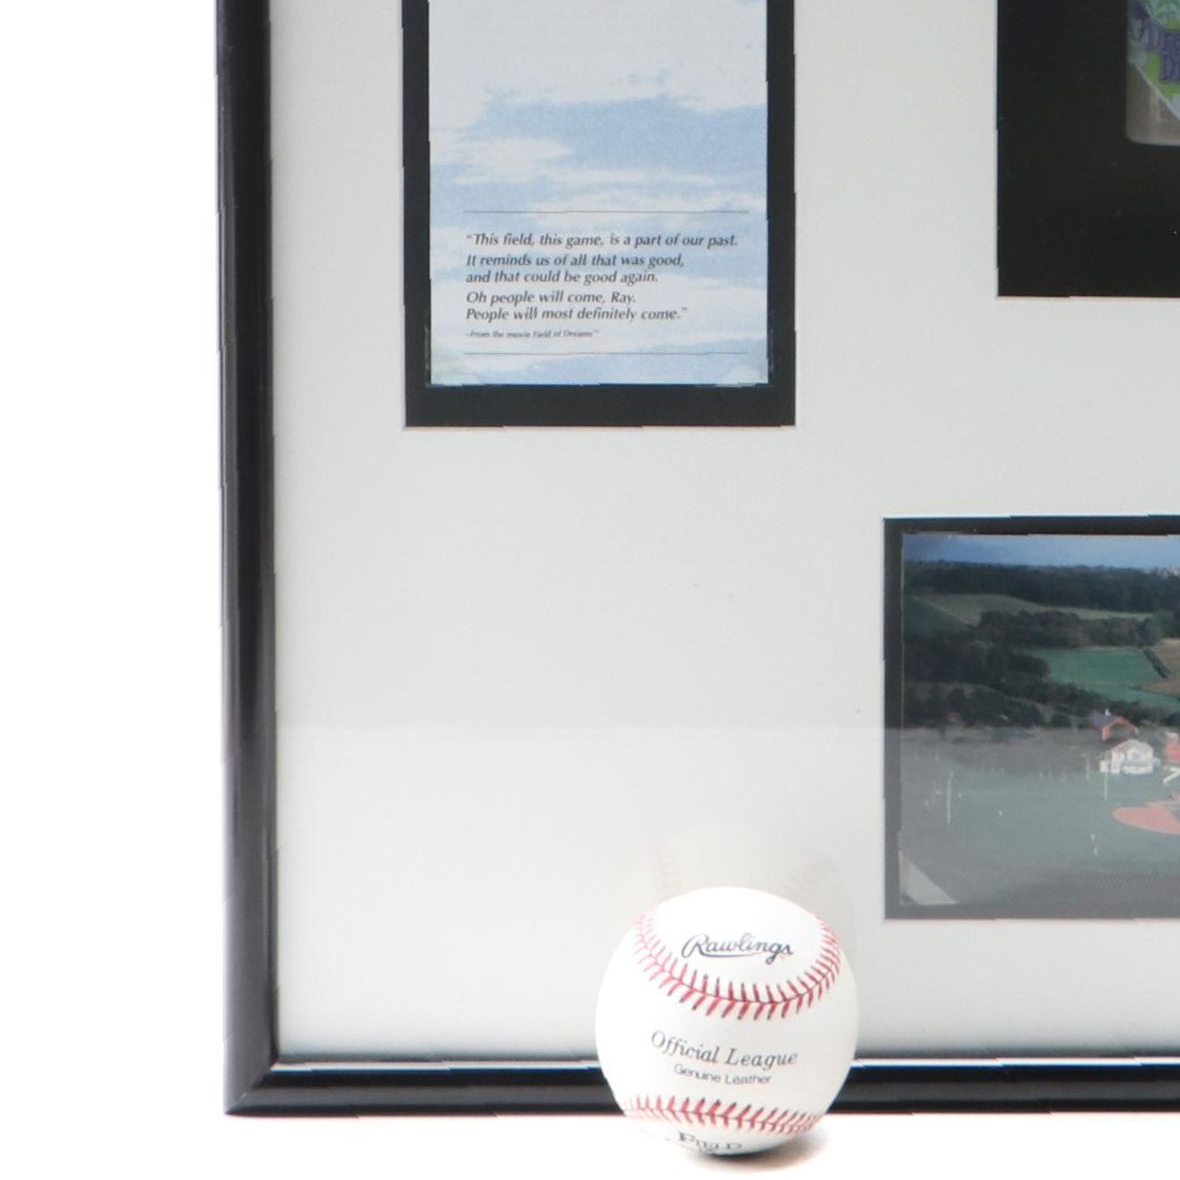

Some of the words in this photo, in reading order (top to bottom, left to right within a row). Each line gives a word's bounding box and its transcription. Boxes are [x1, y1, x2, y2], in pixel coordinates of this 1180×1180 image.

[539, 233, 563, 246] this
[609, 234, 620, 246] is
[623, 236, 632, 246] a
[634, 234, 662, 249] part
[665, 233, 683, 247] of
[682, 236, 704, 246] our
[466, 254, 477, 267] It
[480, 253, 533, 267] reminds
[535, 256, 550, 267] us
[553, 254, 570, 267] of
[570, 254, 588, 267] all
[591, 254, 617, 267] that
[620, 257, 646, 267] was
[466, 271, 491, 283] and
[494, 271, 520, 283] that
[523, 270, 560, 283] could
[564, 270, 581, 283] be
[584, 271, 618, 286] good
[620, 271, 659, 286] again.
[466, 291, 487, 304] Oh
[490, 291, 535, 307] people
[538, 290, 564, 303] will
[610, 291, 637, 306] Ray.
[466, 308, 510, 323] People
[541, 308, 573, 320] most
[577, 306, 638, 323] definitely
[680, 932, 795, 966] Rawlings
[650, 1029, 718, 1065] Official
[724, 1046, 798, 1071] League
[674, 1063, 722, 1084] Genuine
[725, 1070, 773, 1086] Leather
